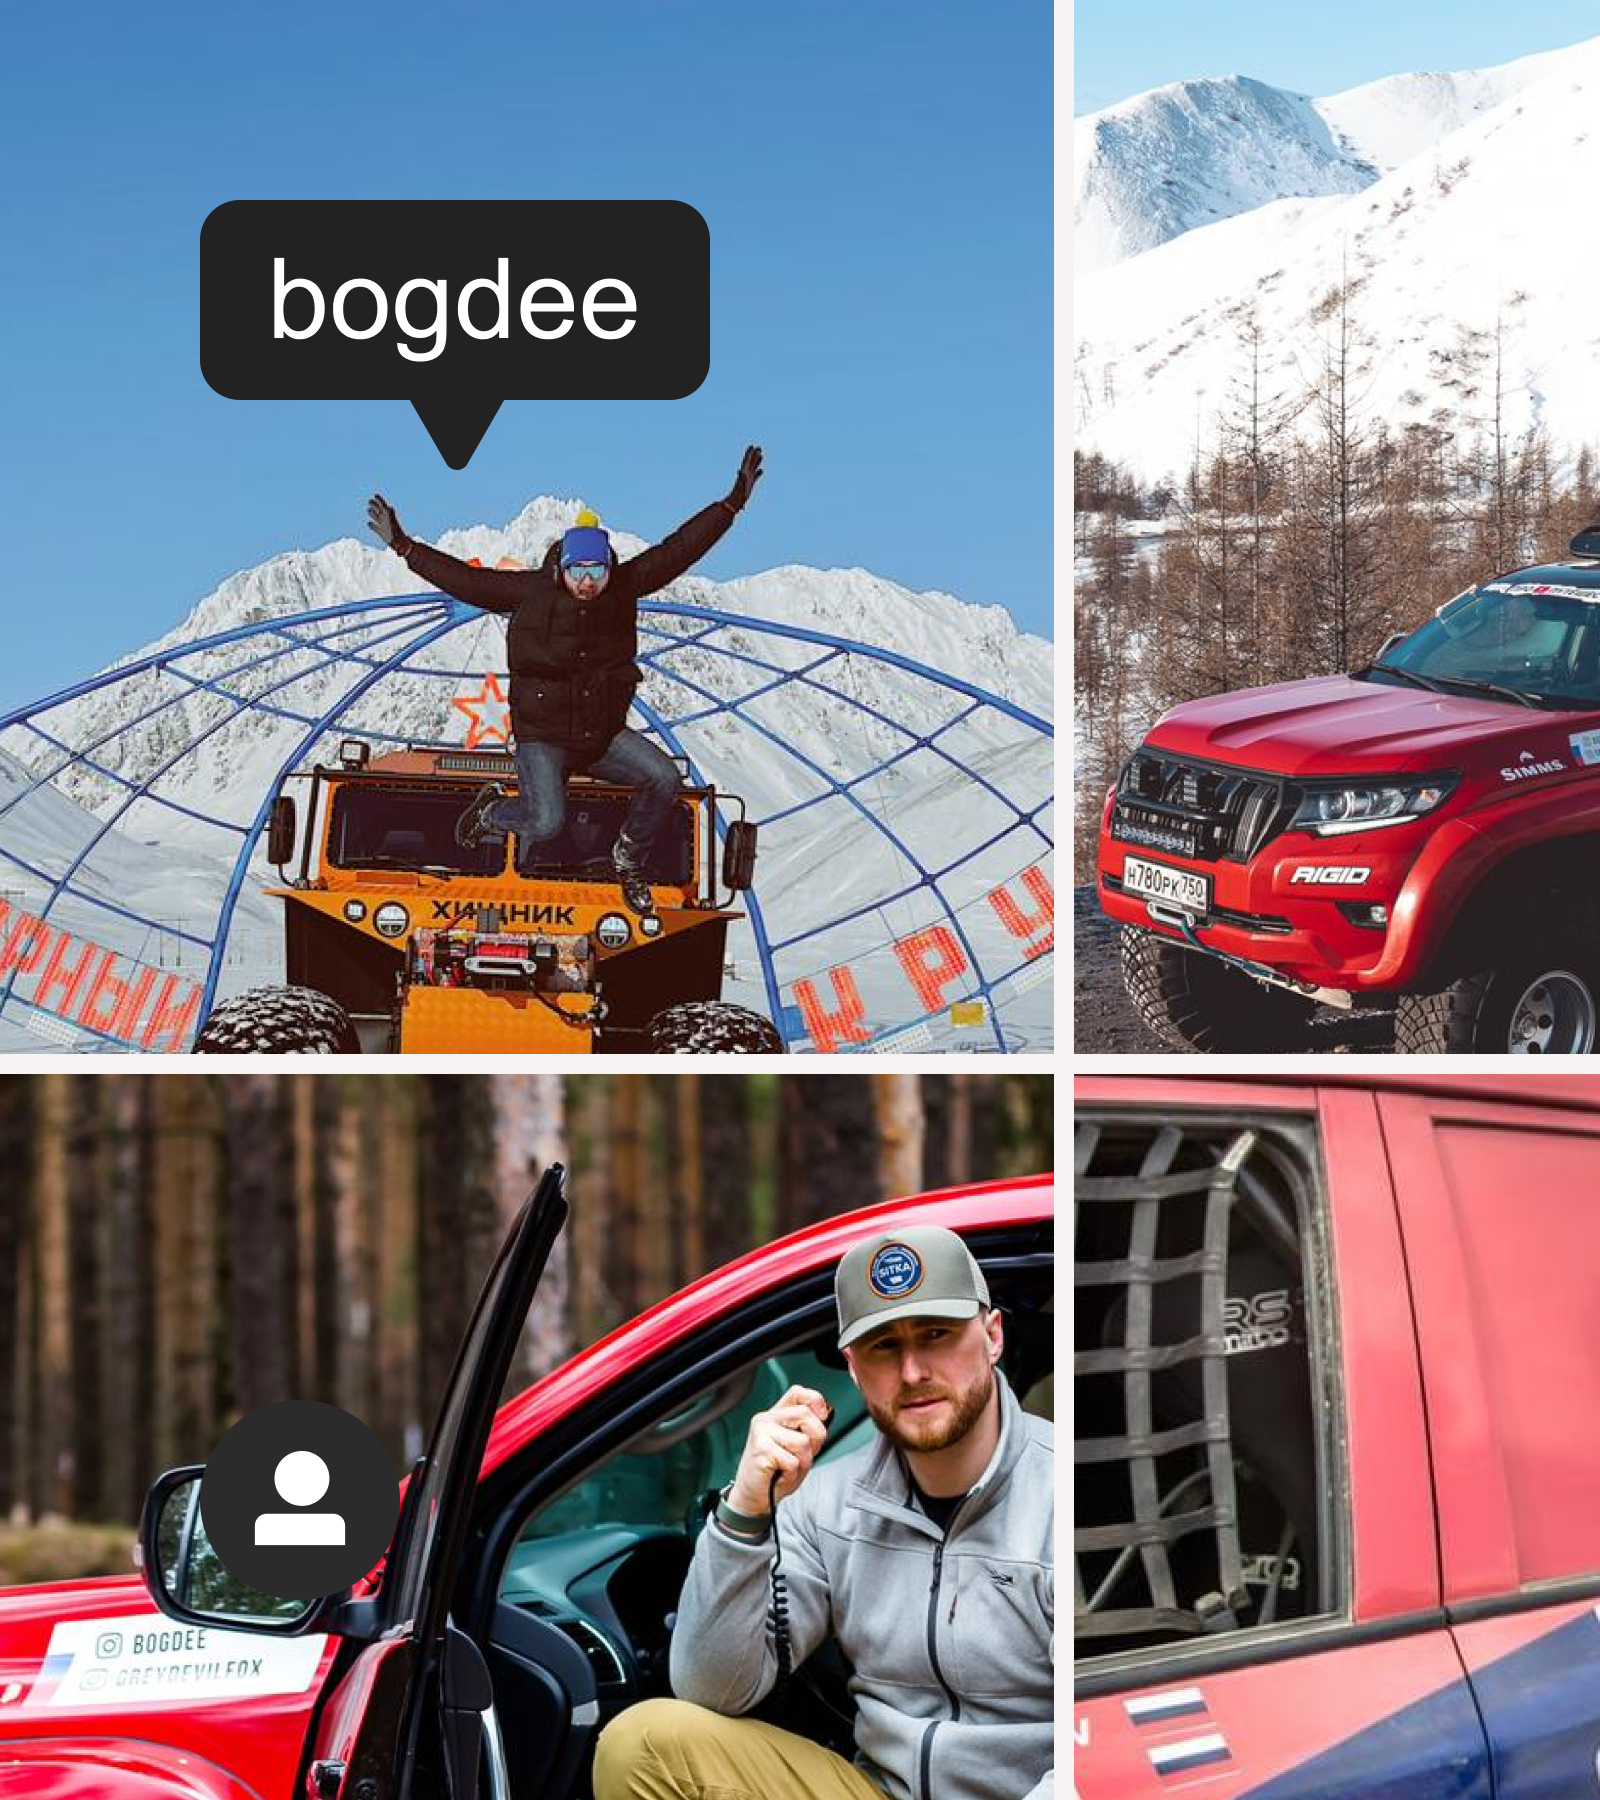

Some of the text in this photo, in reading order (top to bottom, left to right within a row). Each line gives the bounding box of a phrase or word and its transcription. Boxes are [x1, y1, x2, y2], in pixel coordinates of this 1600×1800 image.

[1500, 759, 1564, 781] SIMMS
[1289, 866, 1373, 884] RIGID
[879, 1261, 911, 1279] SITKA
[133, 1628, 207, 1654] BOGDEE
[115, 1657, 264, 1687] GREYDEVILFOX
